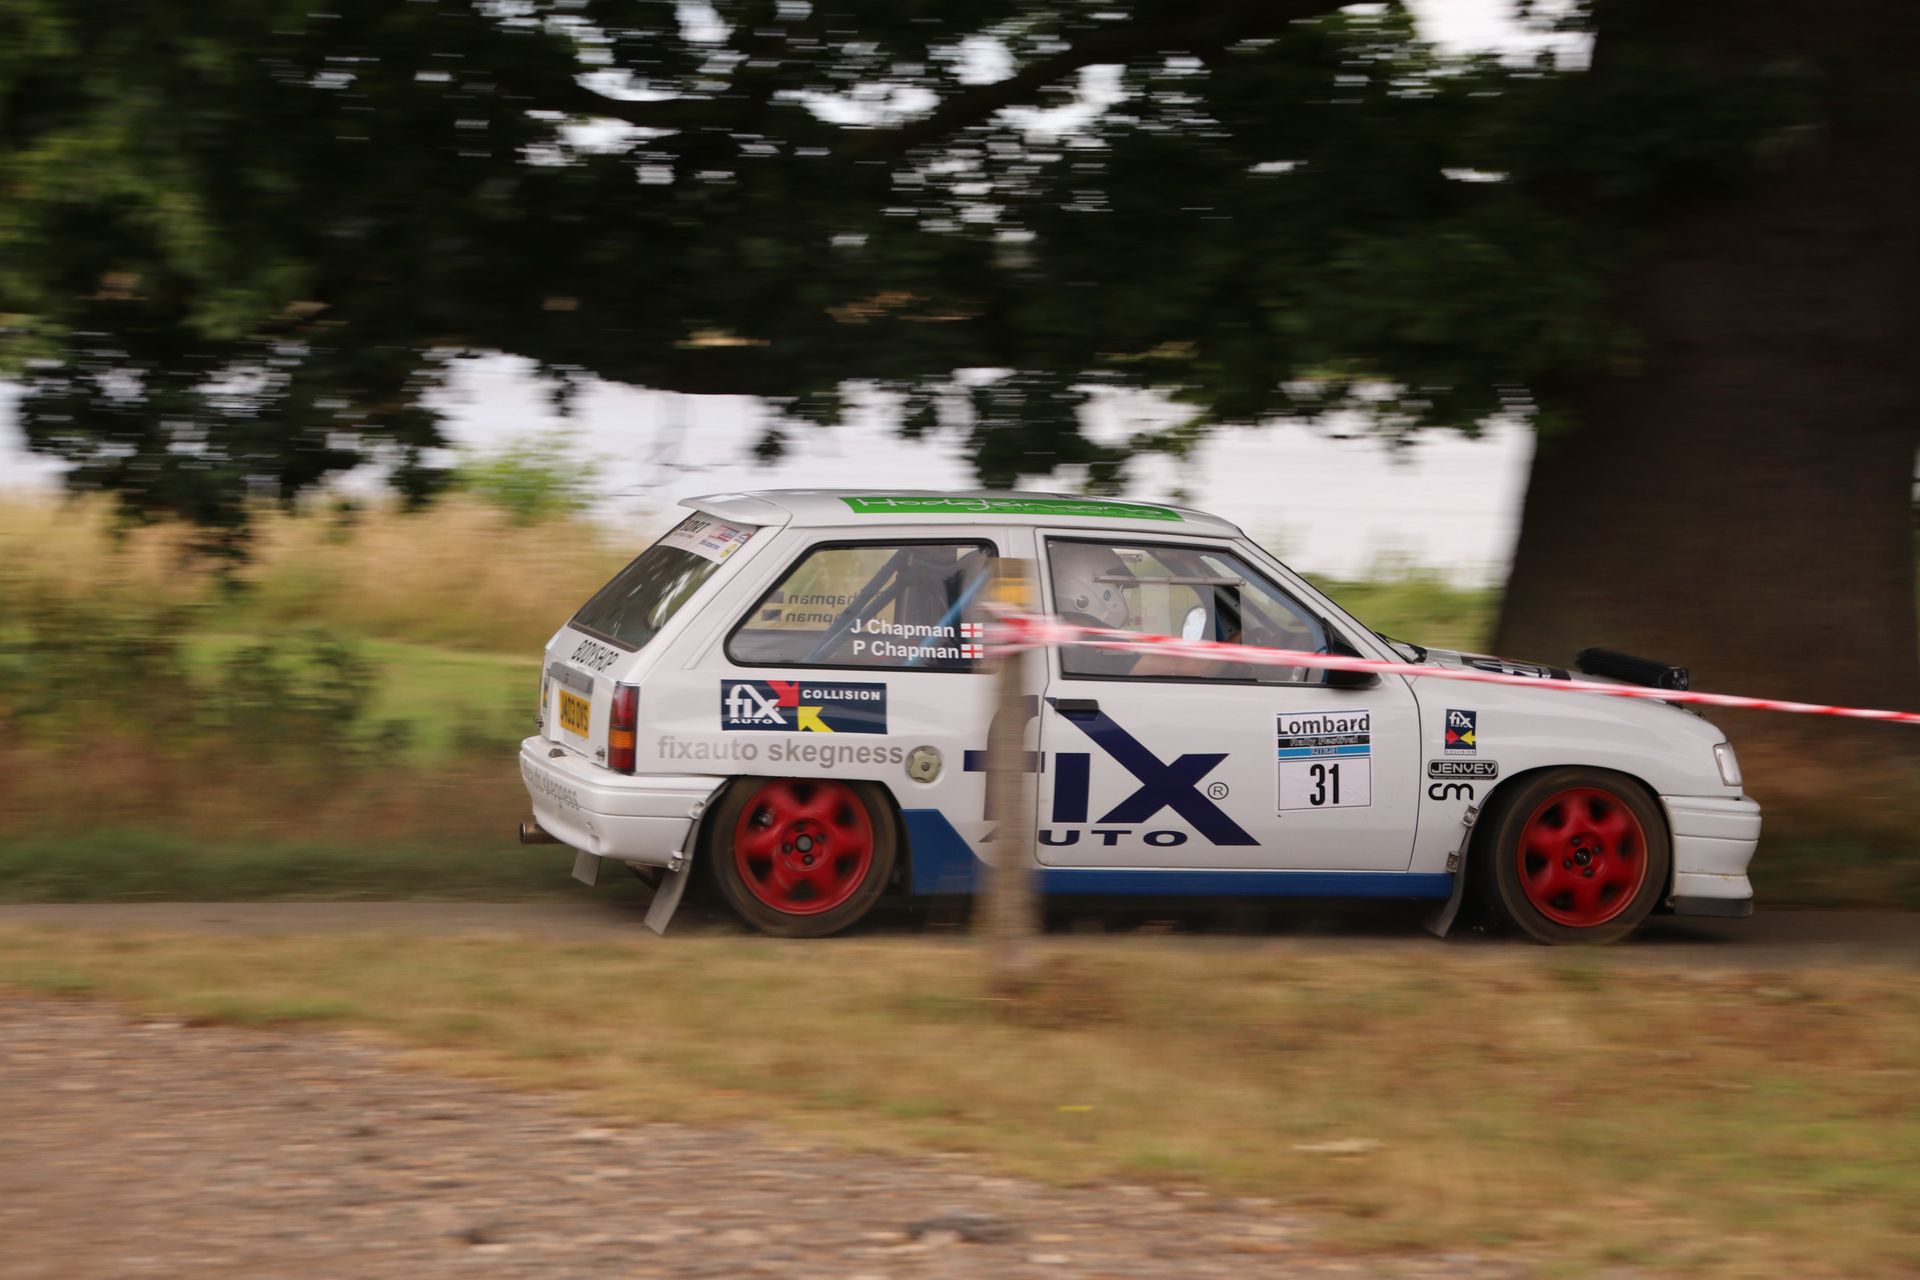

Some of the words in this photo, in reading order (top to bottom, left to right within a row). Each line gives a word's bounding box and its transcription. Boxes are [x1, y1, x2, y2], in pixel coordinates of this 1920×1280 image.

[850, 619, 861, 634] J
[867, 619, 955, 639] Chapman
[853, 640, 866, 655] P
[872, 641, 960, 660] Chapman
[802, 690, 880, 700] COLLISION
[1277, 714, 1370, 735] Lombard
[657, 736, 758, 760] fixauto
[768, 738, 903, 768] skegness
[1431, 763, 1495, 774] JENVEY
[1310, 763, 1339, 806] 31
